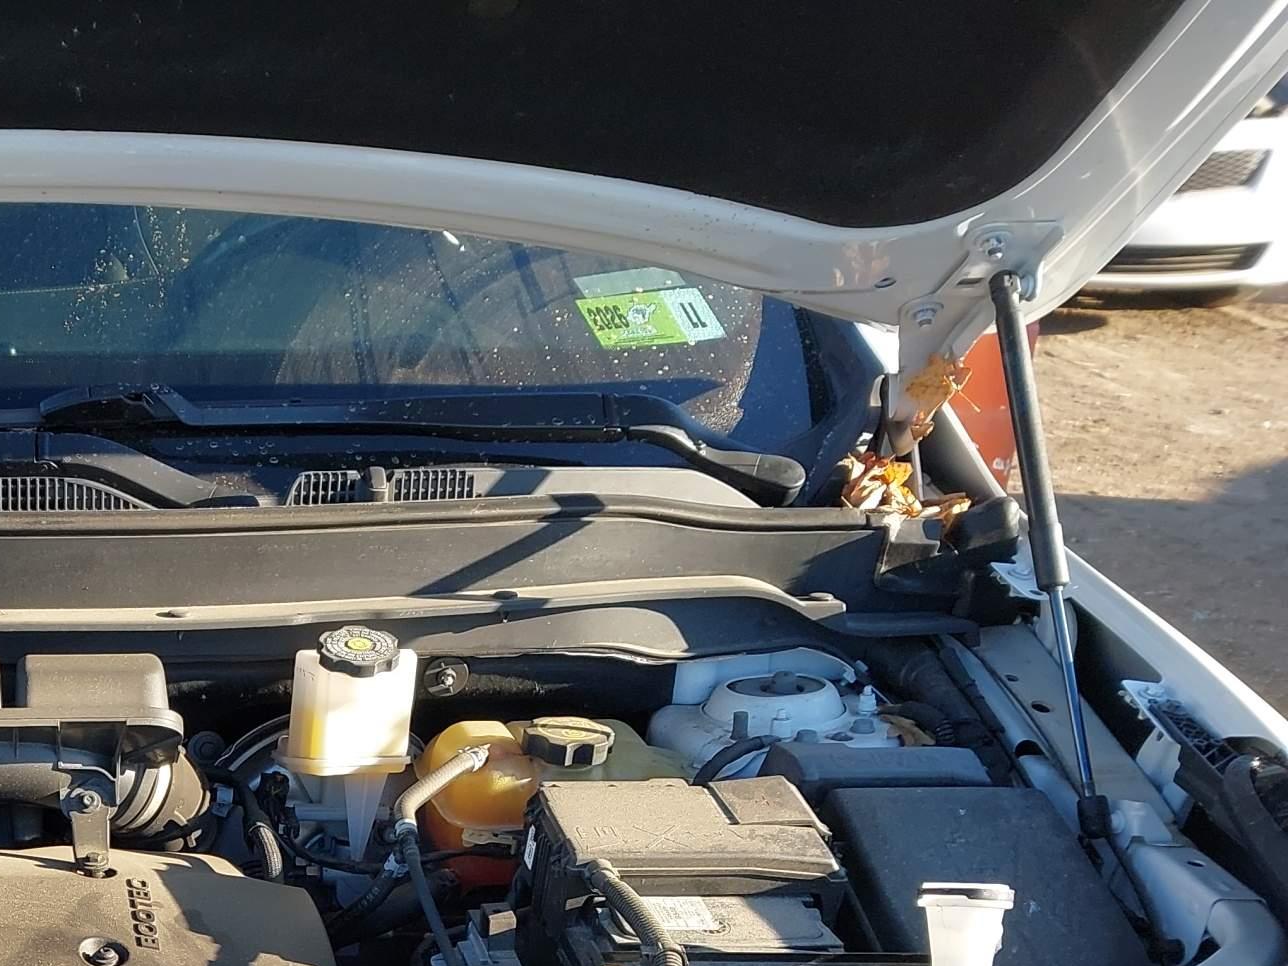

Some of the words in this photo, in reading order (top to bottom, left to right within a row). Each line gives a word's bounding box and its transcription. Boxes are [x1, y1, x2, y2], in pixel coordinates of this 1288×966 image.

[587, 304, 630, 331] 2026
[680, 302, 708, 328] 11
[125, 878, 160, 951] ECOTEC
